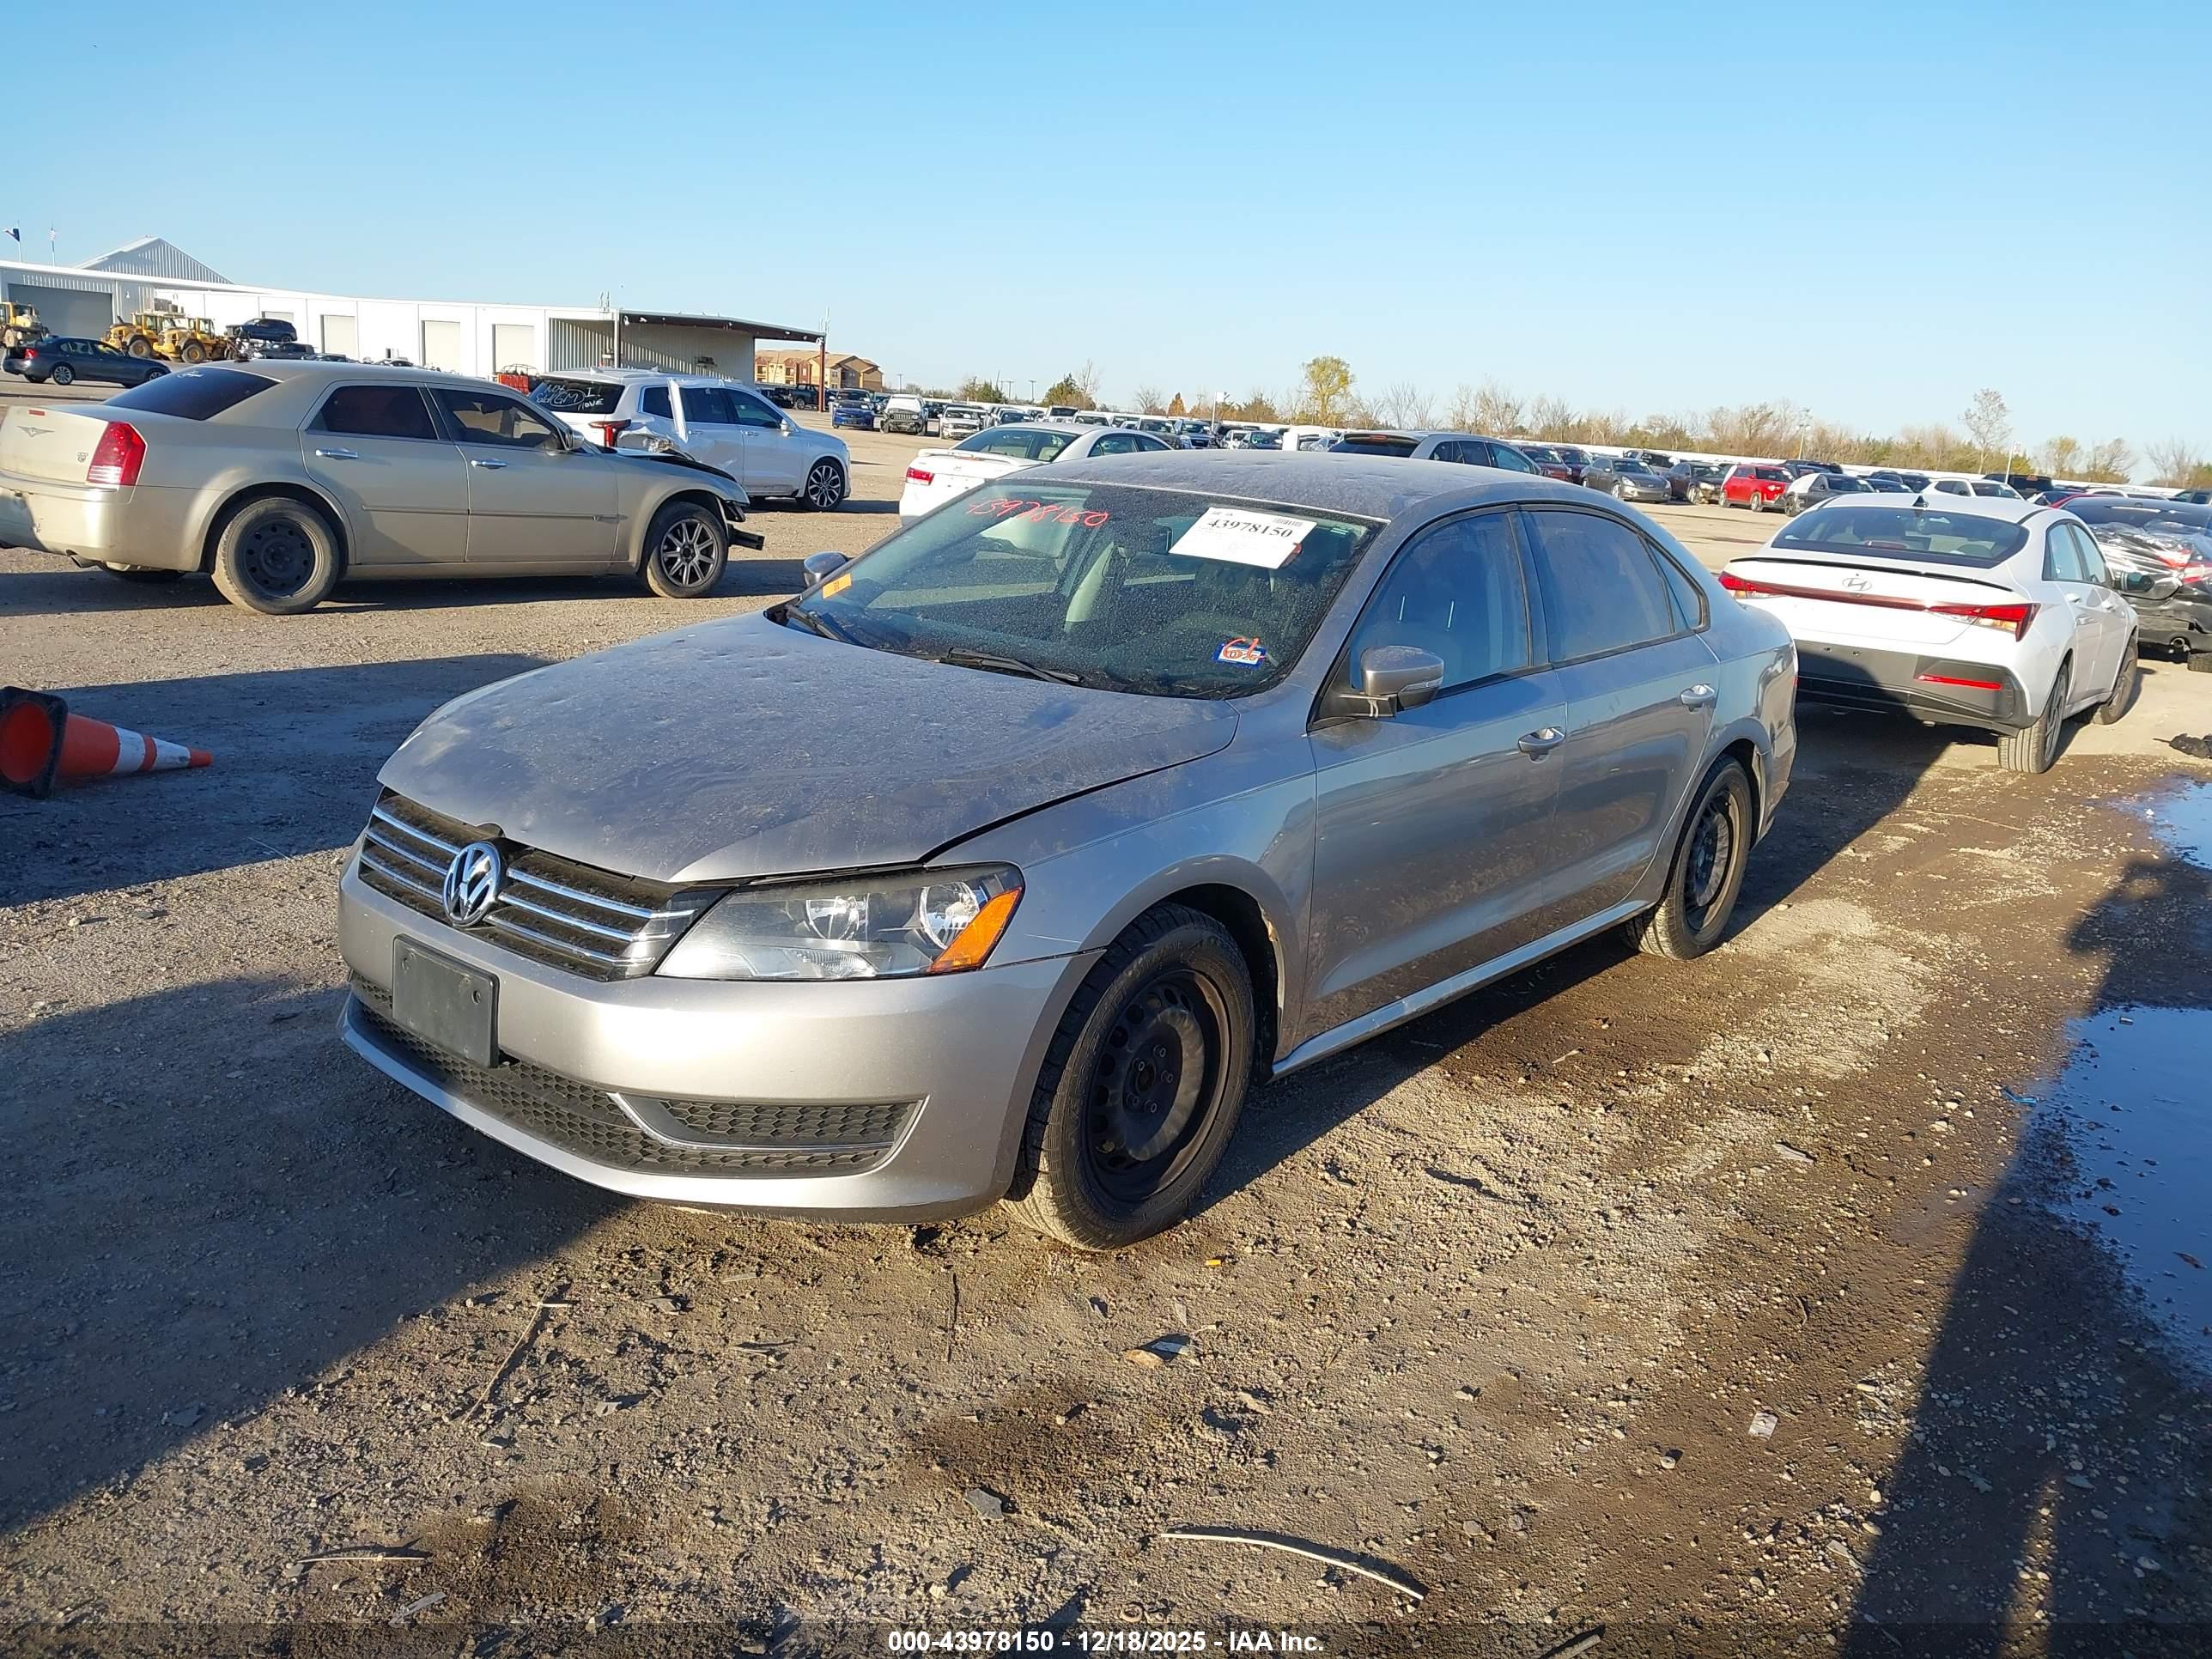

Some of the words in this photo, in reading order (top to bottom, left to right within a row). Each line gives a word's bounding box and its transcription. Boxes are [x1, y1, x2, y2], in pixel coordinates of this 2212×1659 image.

[553, 393, 579, 404] GM
[965, 497, 1109, 526] 43978150
[1207, 518, 1293, 538] 43978150
